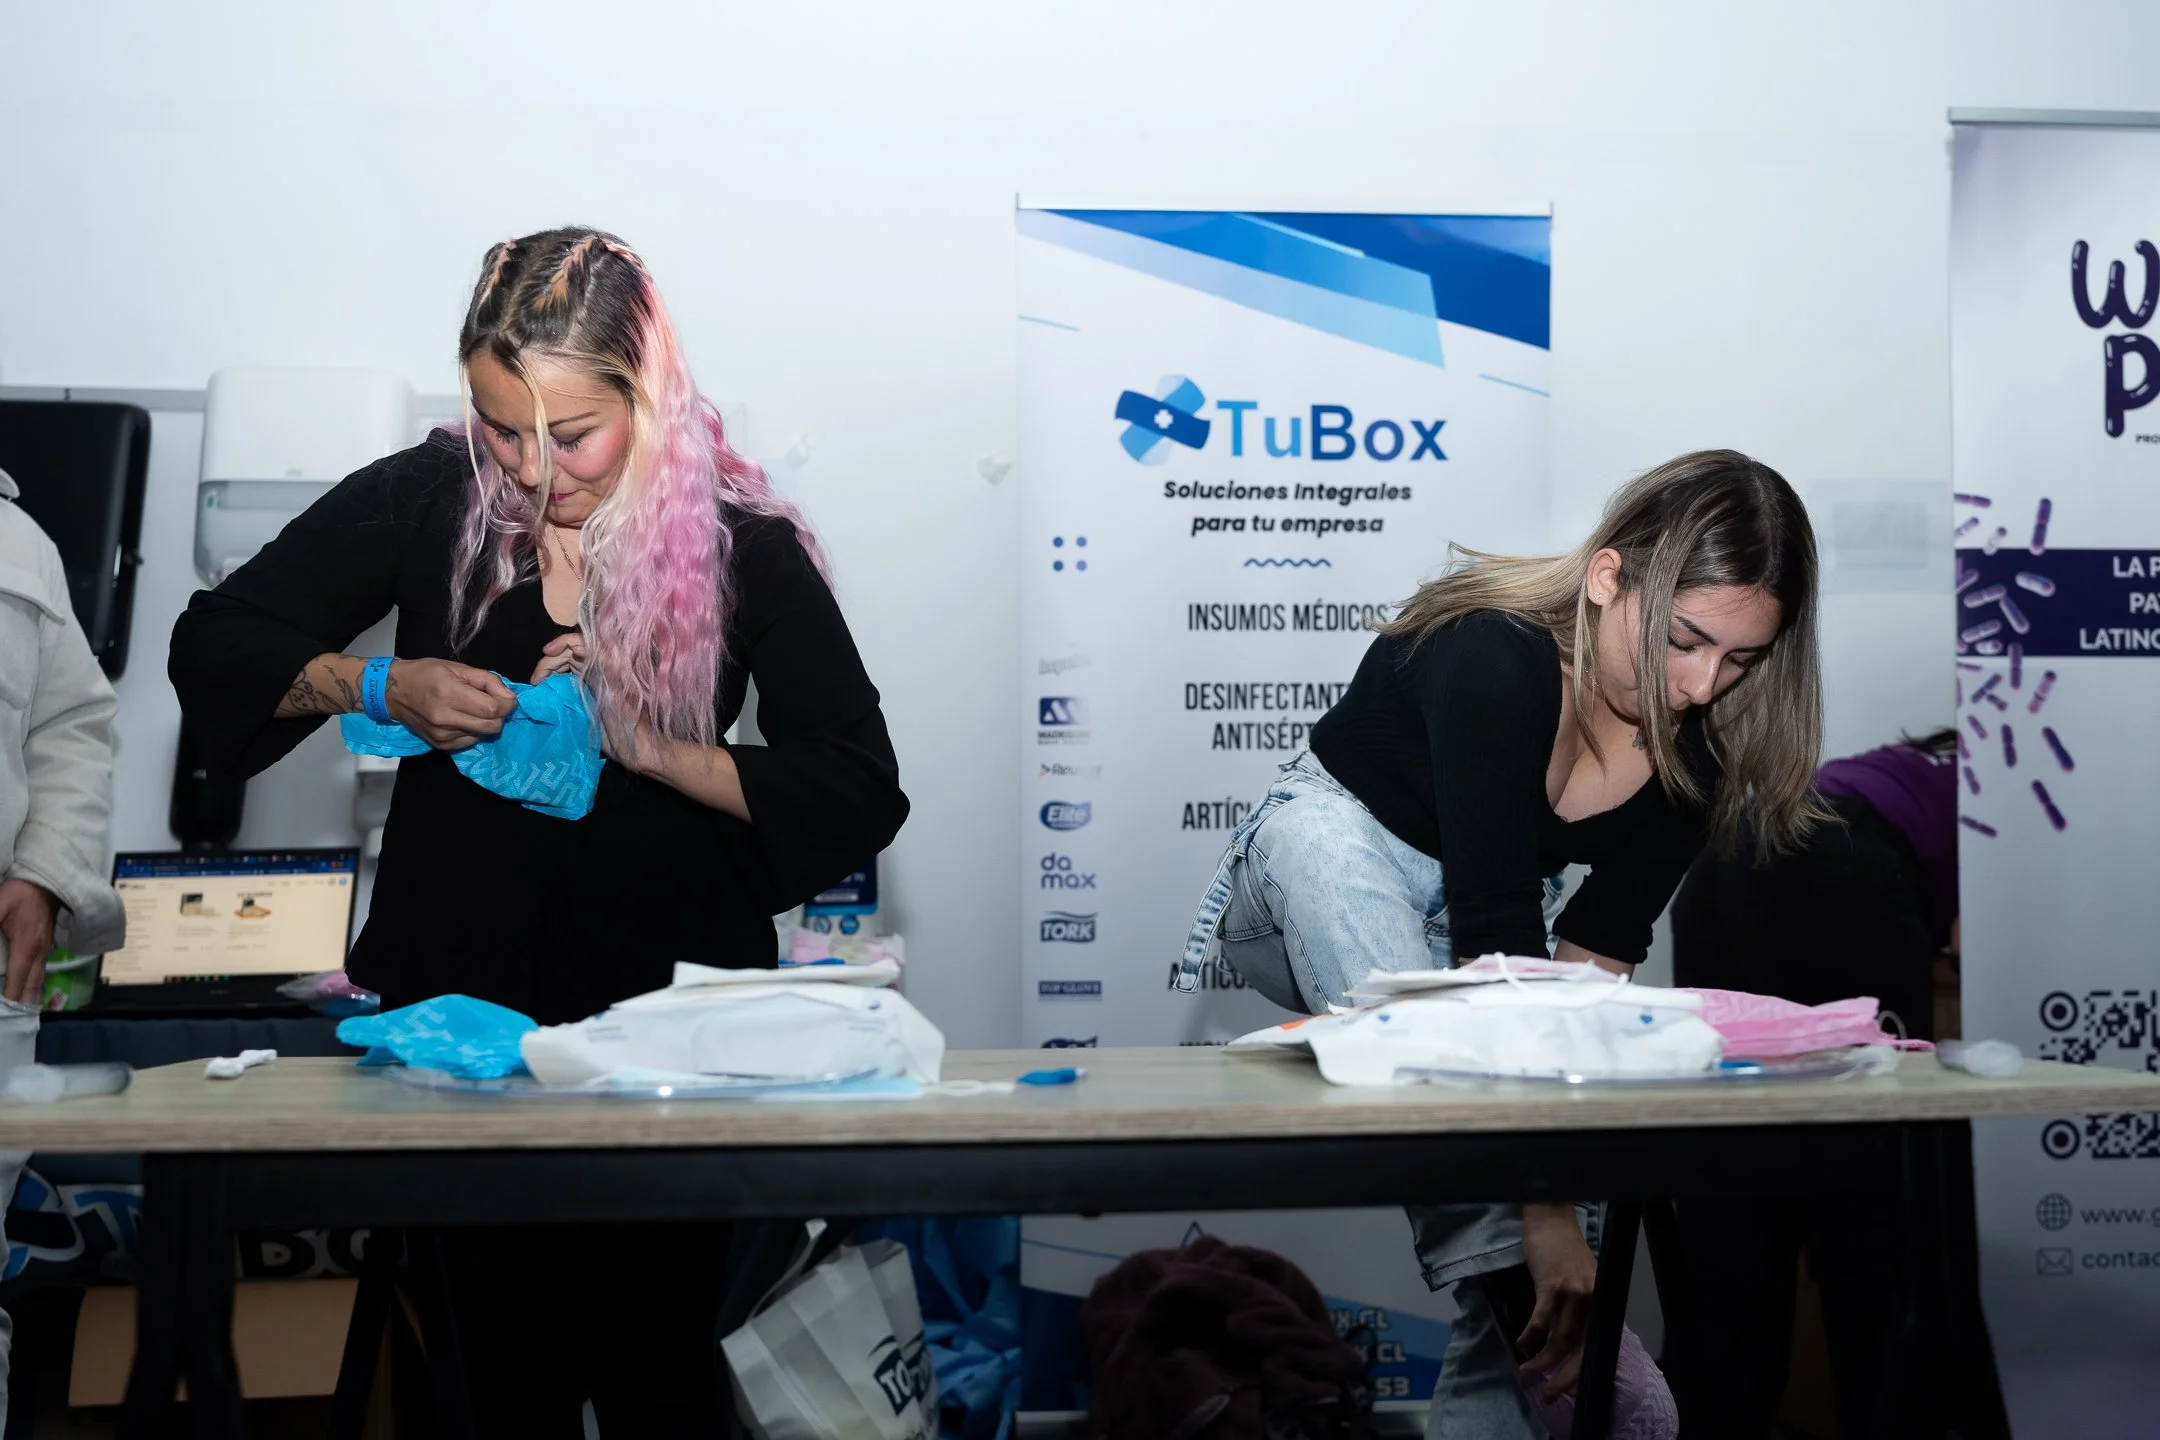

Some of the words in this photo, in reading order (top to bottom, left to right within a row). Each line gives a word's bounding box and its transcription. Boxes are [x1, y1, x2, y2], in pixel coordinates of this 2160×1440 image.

[1217, 400, 1449, 461] TuBox
[1164, 481, 1288, 499] Soluciones
[1295, 482, 1412, 506] Integrales
[1191, 516, 1246, 537] para
[1252, 515, 1275, 532] tu
[1281, 518, 1384, 538] empresa
[2113, 556, 2145, 578] LA
[2129, 592, 2160, 614] PA
[1188, 604, 1286, 632] INSUMOS
[1293, 598, 1388, 632] MÉDICOS
[1185, 682, 1351, 710] DESINFECTANT
[1182, 796, 1251, 830] ARTÍC
[1041, 852, 1072, 871] da
[1041, 873, 1096, 889] max
[1043, 922, 1092, 940] TORK
